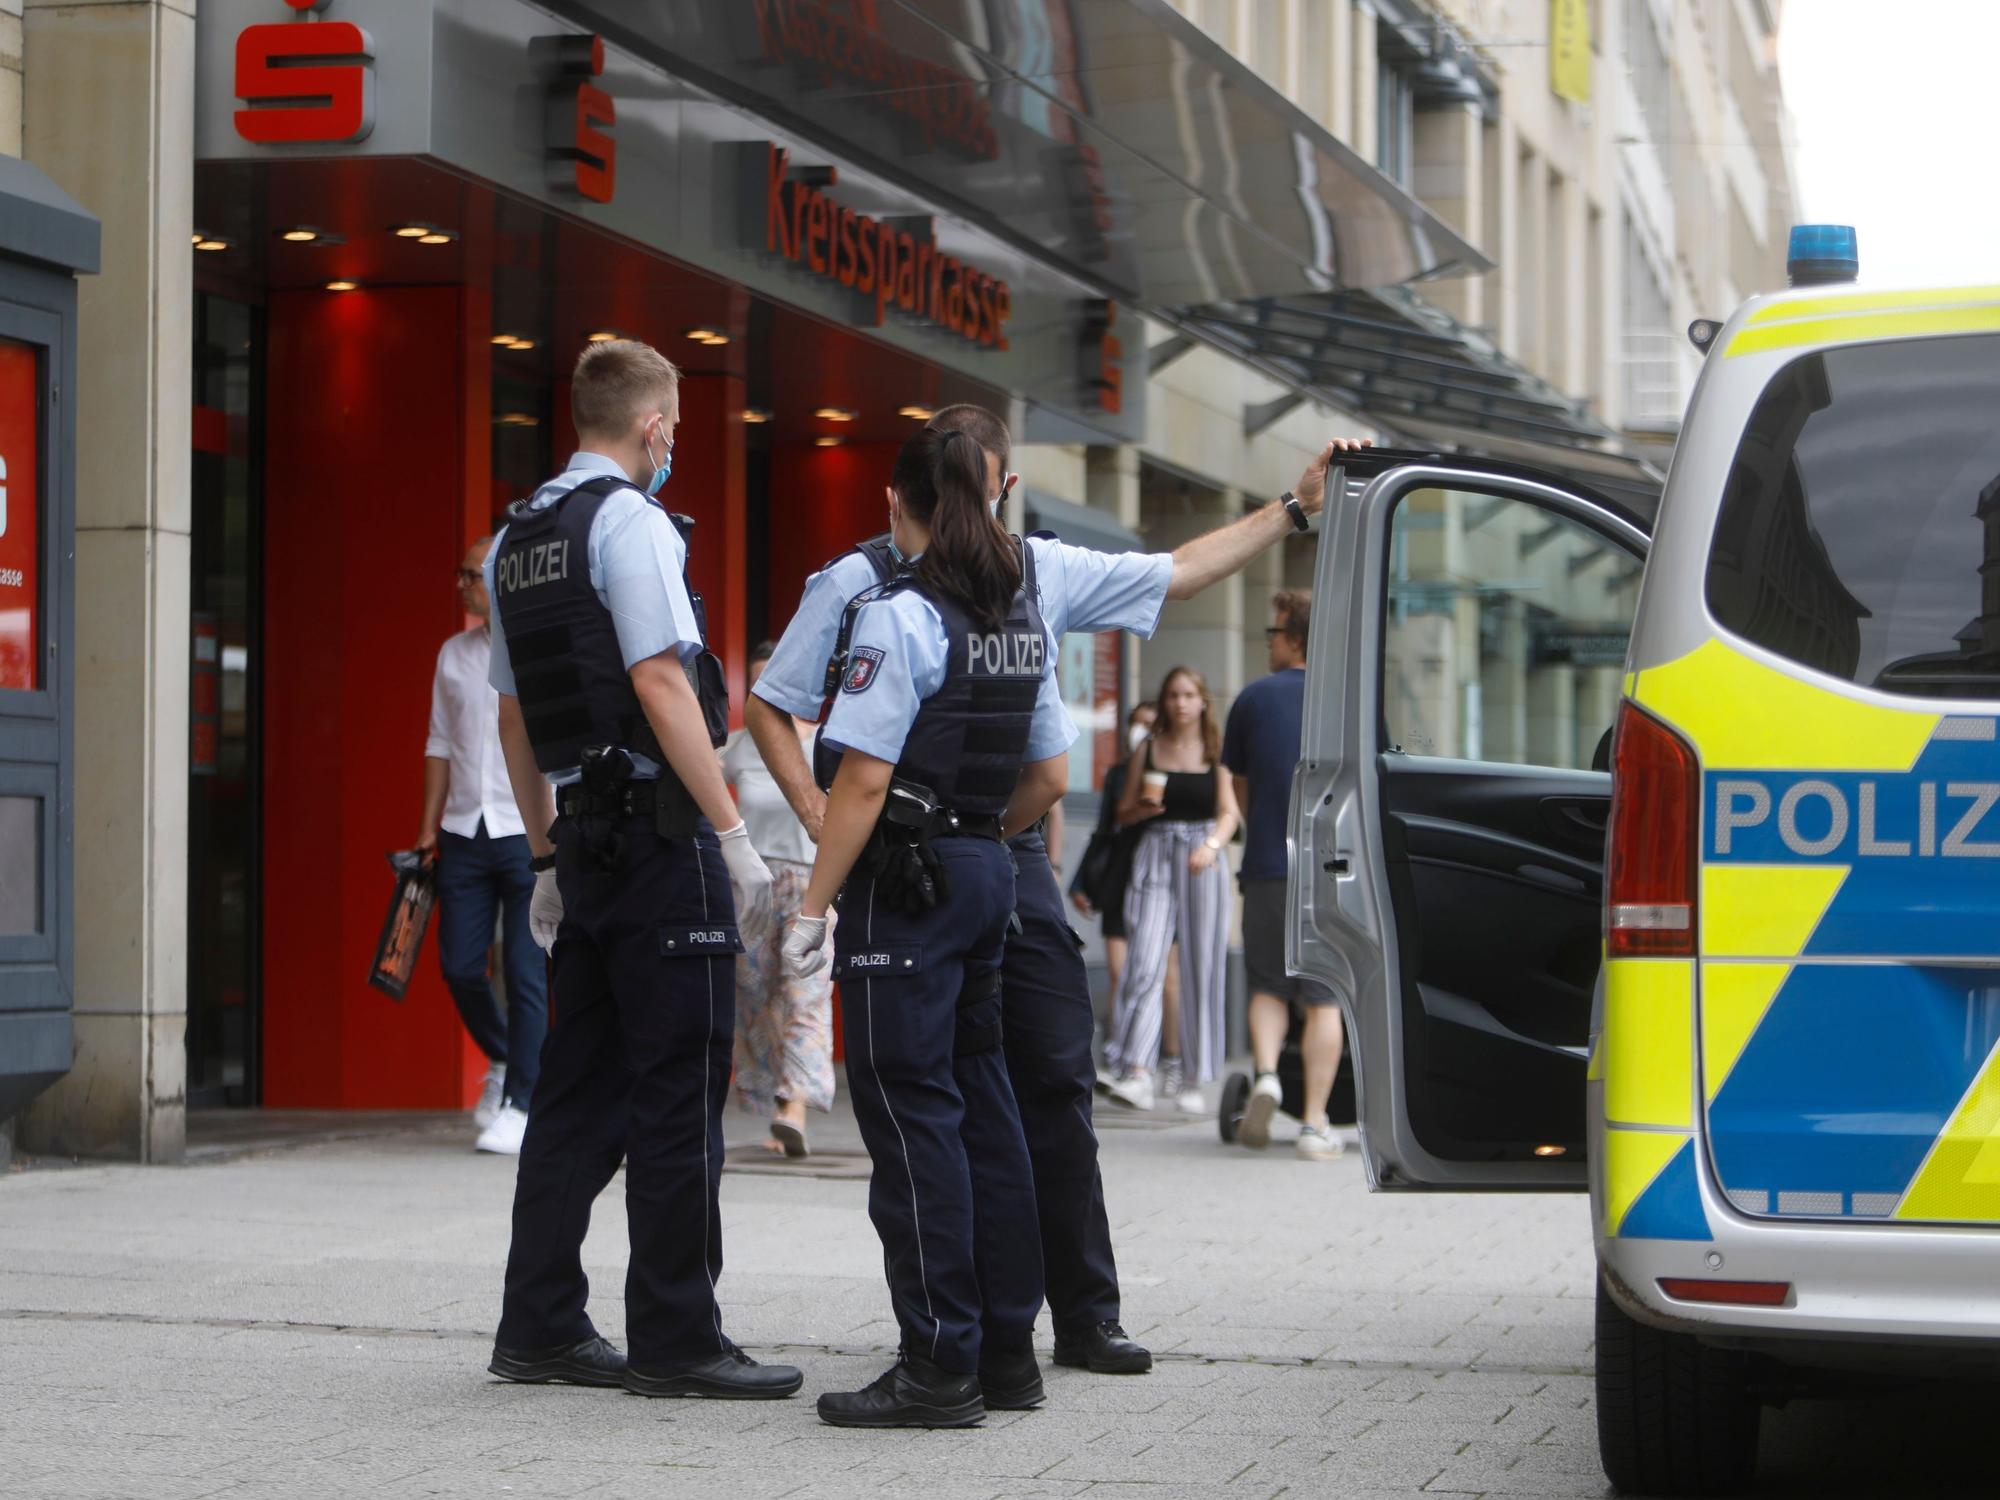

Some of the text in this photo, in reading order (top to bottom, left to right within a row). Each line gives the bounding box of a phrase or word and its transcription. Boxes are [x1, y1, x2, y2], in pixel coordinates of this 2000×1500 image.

[768, 140, 1012, 352] Kreissparkasse
[499, 539, 569, 597] POLIZEI
[967, 633, 1045, 675] POLIZEI
[1714, 780, 2000, 857] POLIZ
[689, 931, 726, 944] POLIZEI
[851, 954, 890, 967] POLIZEI
